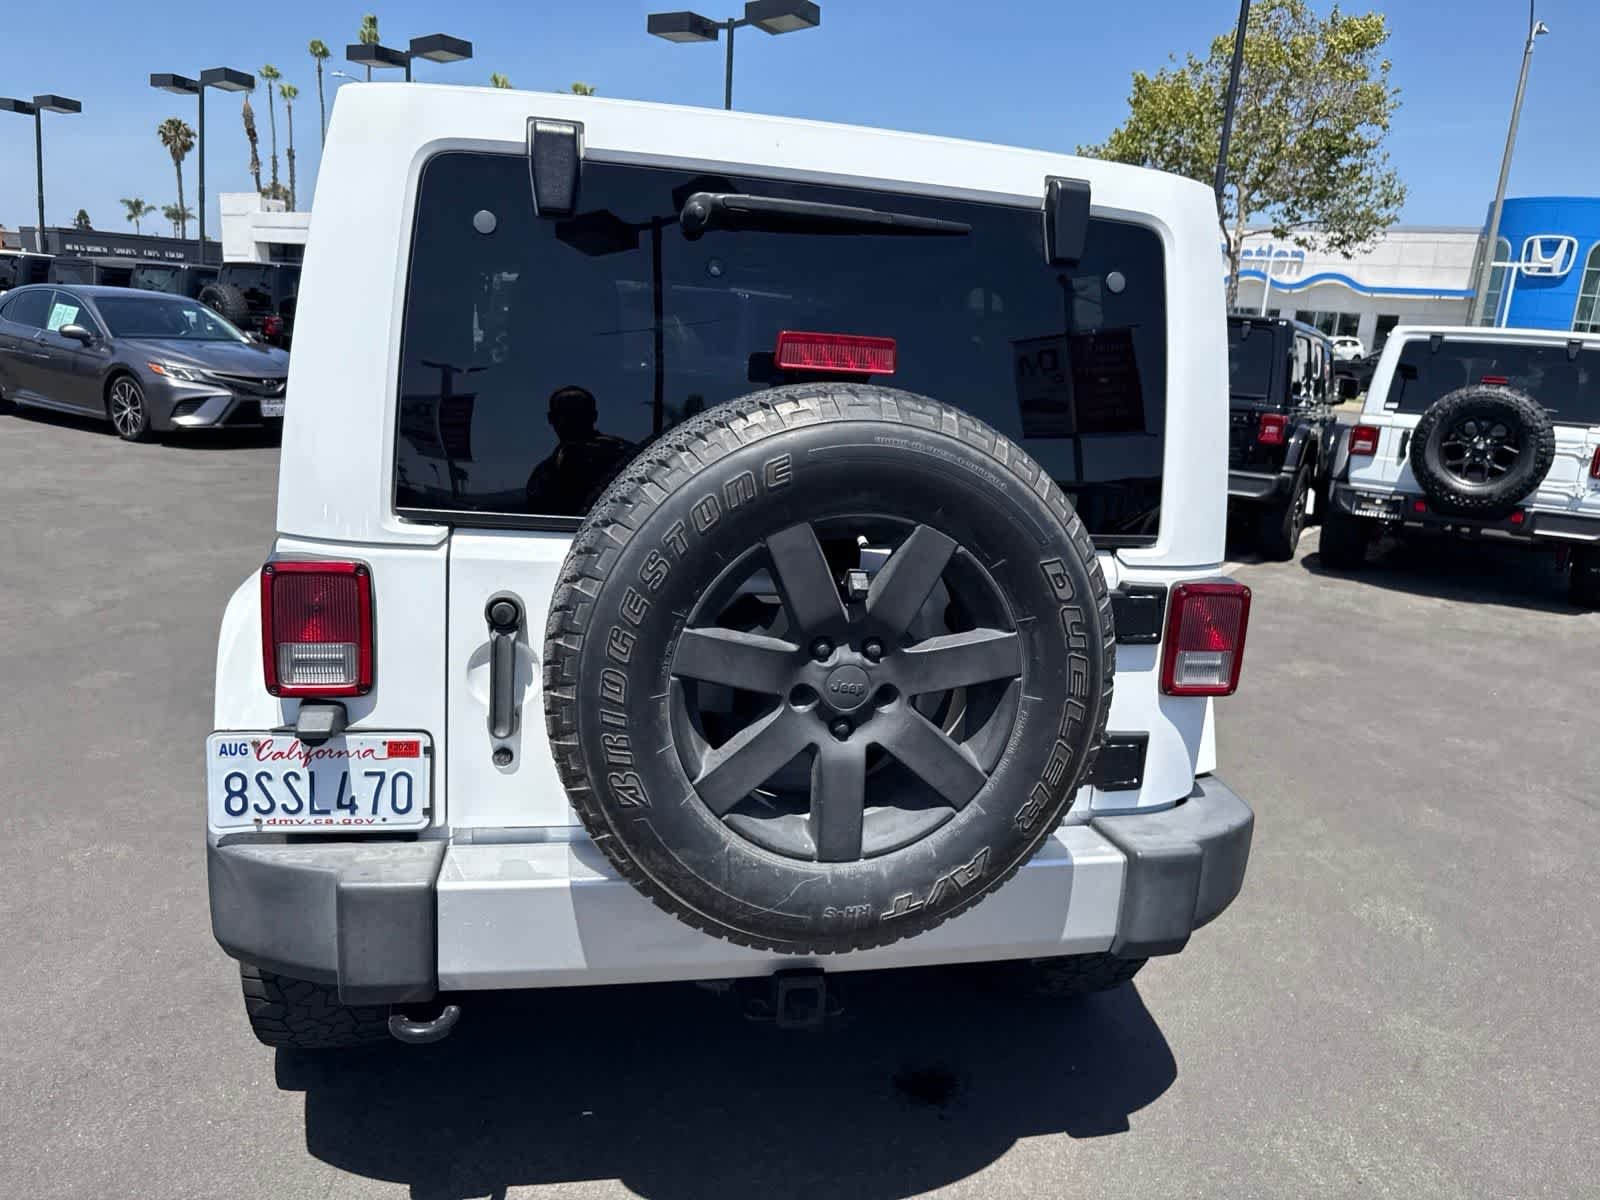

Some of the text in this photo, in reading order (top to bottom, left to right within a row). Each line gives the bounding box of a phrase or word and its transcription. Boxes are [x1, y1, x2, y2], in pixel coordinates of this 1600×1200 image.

[601, 453, 793, 809] BRIDGESTONE
[830, 679, 865, 697] Jeep
[1015, 558, 1089, 833] DUELER
[219, 742, 248, 757] AUG
[255, 738, 388, 769] California
[223, 770, 414, 817] 8SSL470
[266, 817, 375, 826] dmv.ca.gov
